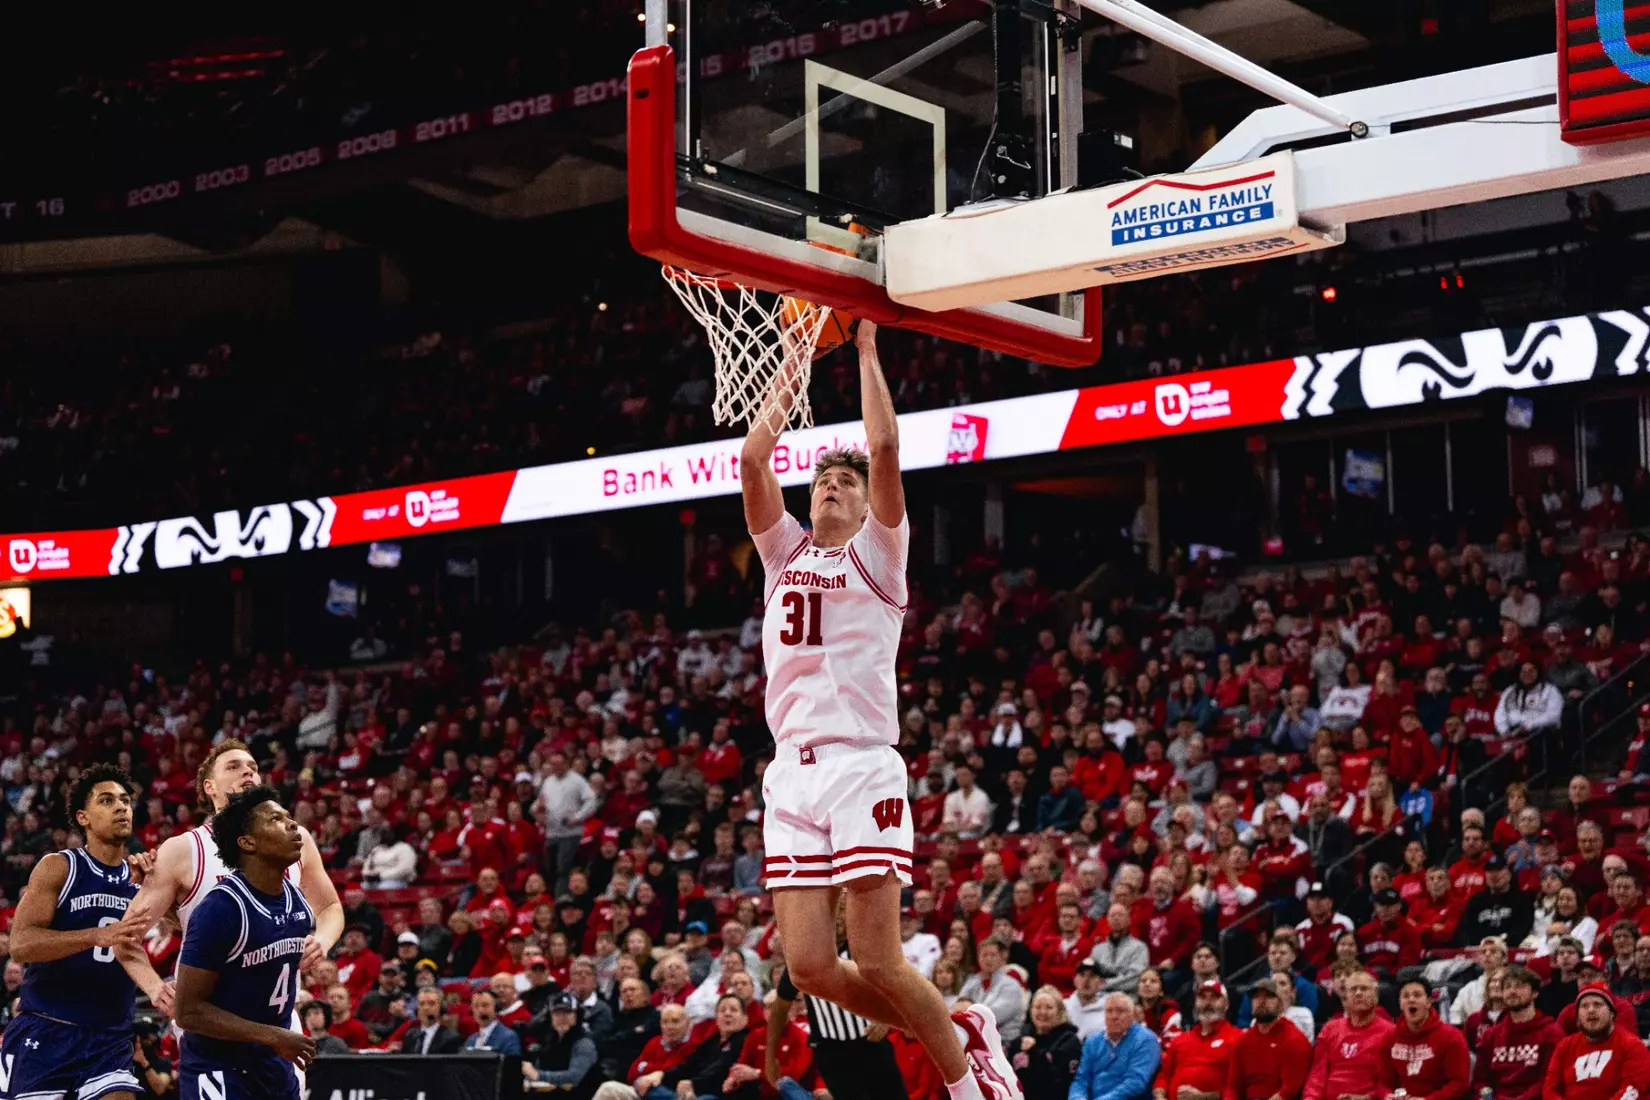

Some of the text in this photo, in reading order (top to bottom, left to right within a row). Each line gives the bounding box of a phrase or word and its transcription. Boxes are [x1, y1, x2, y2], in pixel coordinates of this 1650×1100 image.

[36, 197, 64, 217] 16
[127, 179, 180, 207] 2000
[195, 164, 249, 192] 2003
[414, 112, 470, 142] 2011
[491, 93, 554, 125] 2012
[839, 9, 910, 46] 2017
[1111, 183, 1273, 228] AMERICAN FAMILY
[1123, 207, 1263, 241] INSURANCE
[603, 461, 673, 497] Bank
[686, 452, 739, 485] Wit
[779, 570, 847, 590] SCONSIN
[780, 591, 823, 646] 31
[871, 797, 904, 833] W
[268, 963, 290, 1015] 4
[1574, 1049, 1613, 1082] W
